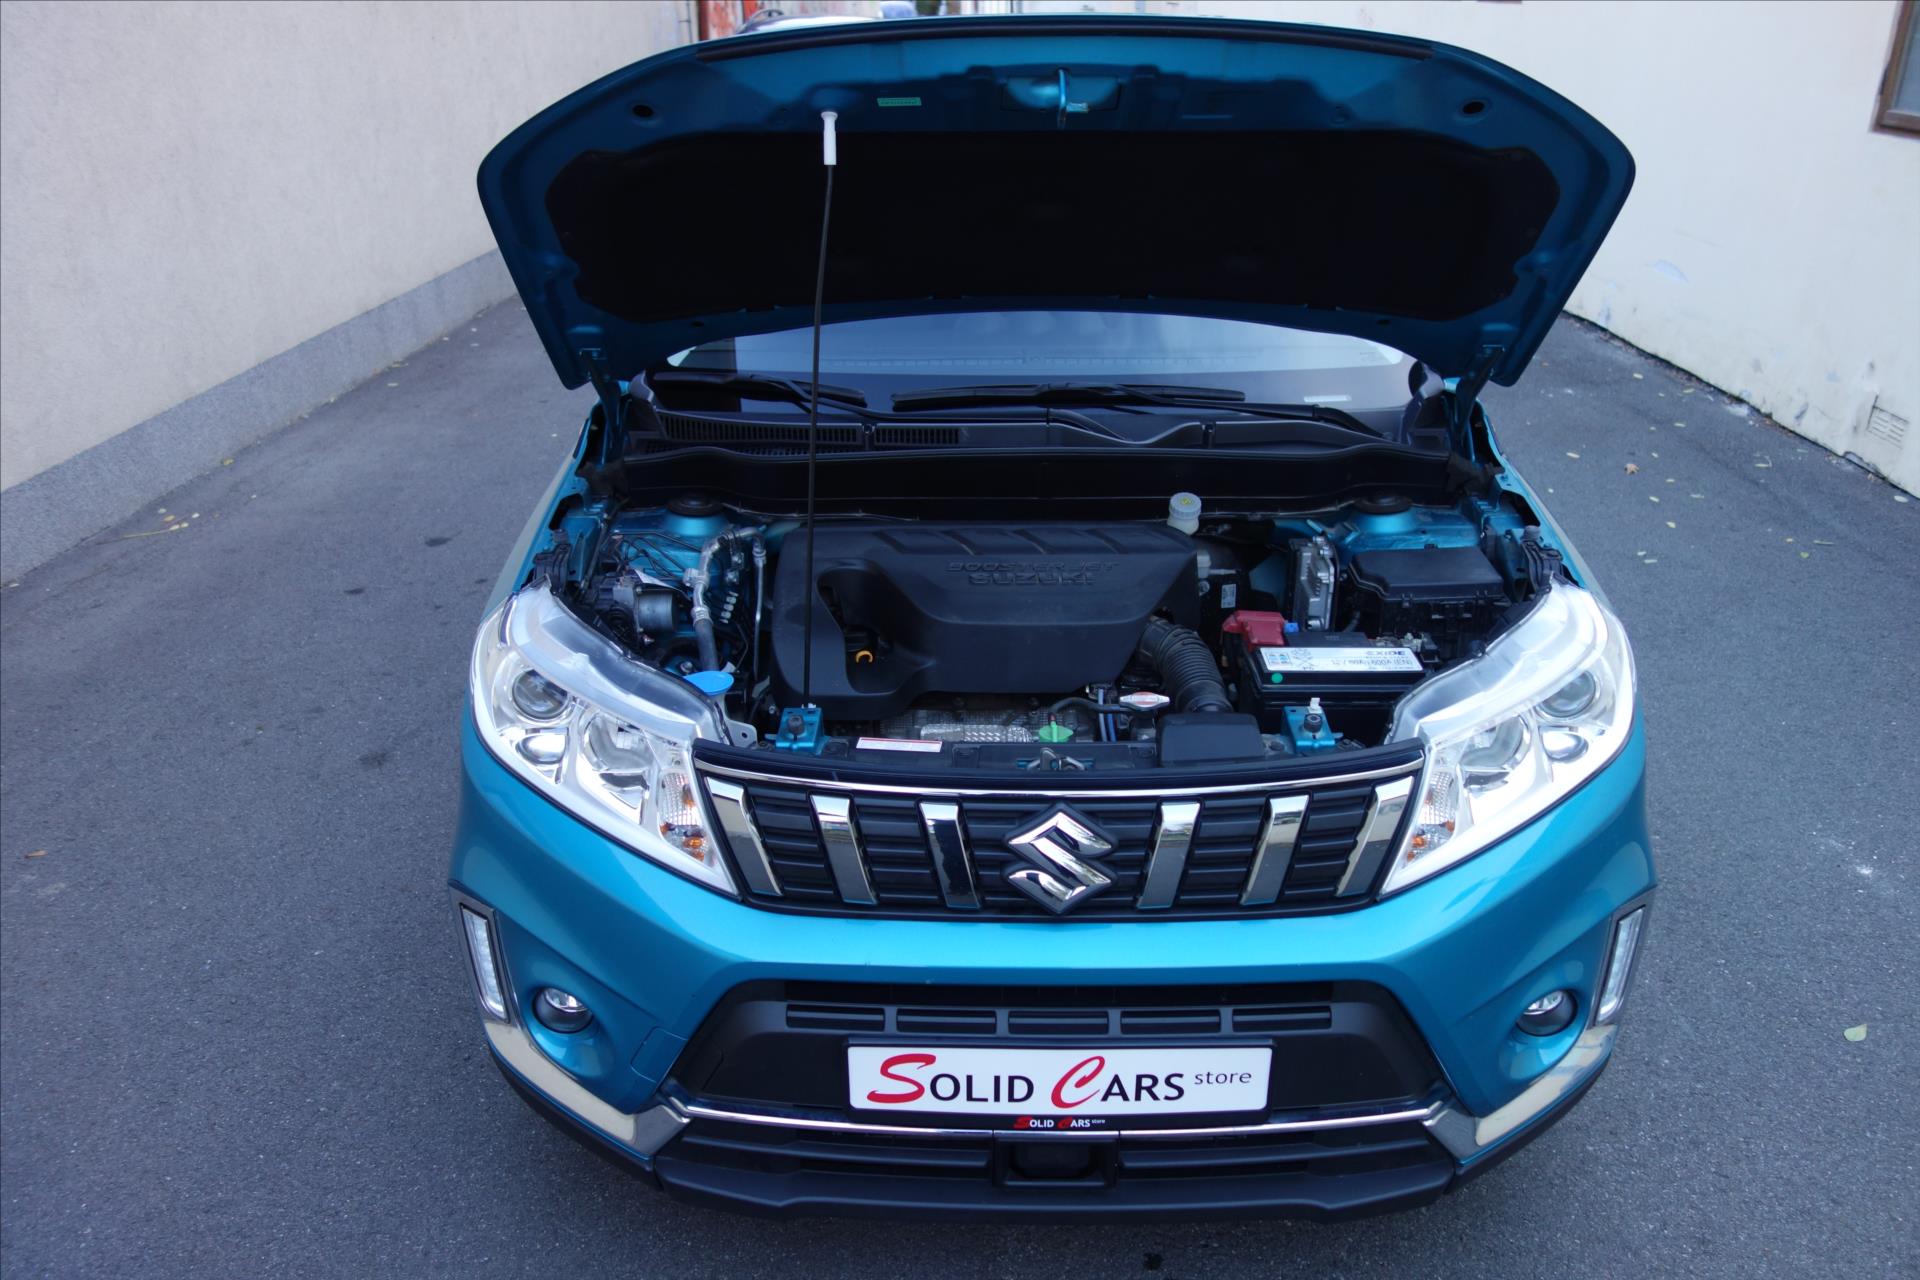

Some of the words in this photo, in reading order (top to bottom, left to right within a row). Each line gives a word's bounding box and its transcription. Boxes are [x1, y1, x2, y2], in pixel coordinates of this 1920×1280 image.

[968, 572, 1096, 586] SUZUKI
[867, 1053, 1034, 1104] SOLID
[1051, 1055, 1185, 1109] CARS
[1194, 1071, 1252, 1085] store
[1013, 1115, 1055, 1129] SOLID
